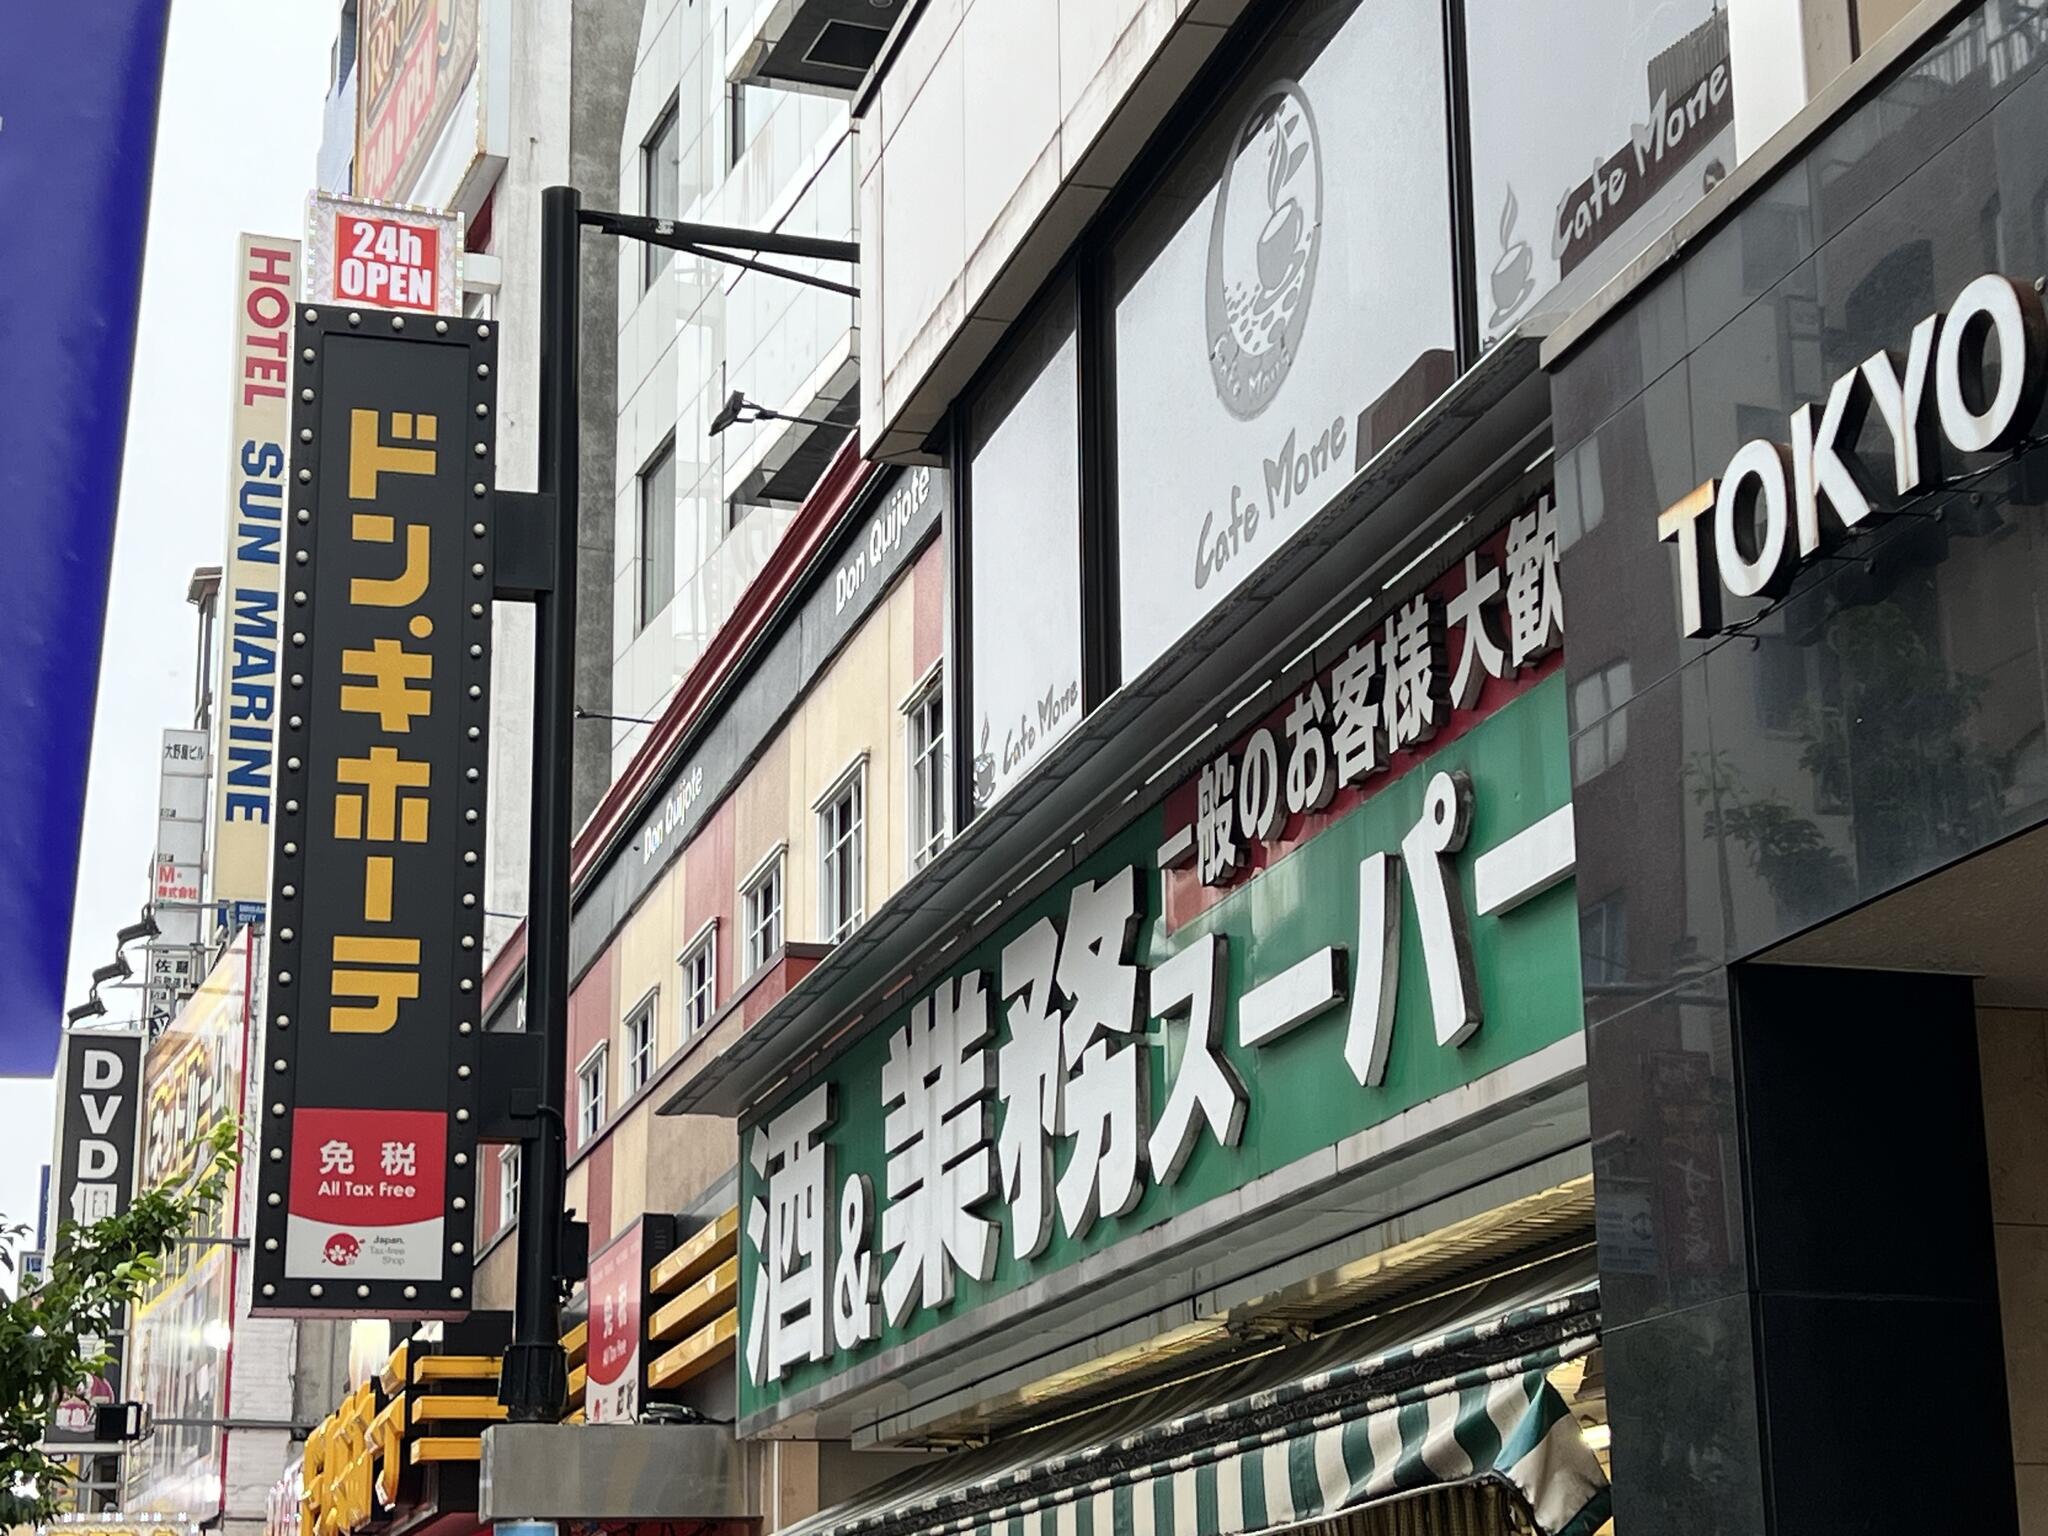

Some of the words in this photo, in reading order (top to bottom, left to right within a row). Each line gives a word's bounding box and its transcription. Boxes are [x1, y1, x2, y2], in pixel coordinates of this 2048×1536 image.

[352, 221, 422, 267] 24h
[1551, 156, 1627, 260] Cafe
[244, 247, 291, 407] HOTEL
[341, 256, 432, 306] OPEN
[237, 439, 285, 565] SUN
[1657, 273, 2028, 639] TOKYO
[835, 551, 865, 616] Don
[870, 466, 930, 568] Quijote
[1195, 484, 1260, 589] Cafe
[225, 588, 280, 825] MARINE
[1003, 714, 1035, 775] Cafe
[643, 820, 664, 865] Don
[665, 767, 702, 834] Quijote
[318, 1181, 340, 1196] All
[345, 1181, 374, 1197] Tax
[379, 1182, 416, 1198] Free
[319, 1140, 417, 1176] 免税
